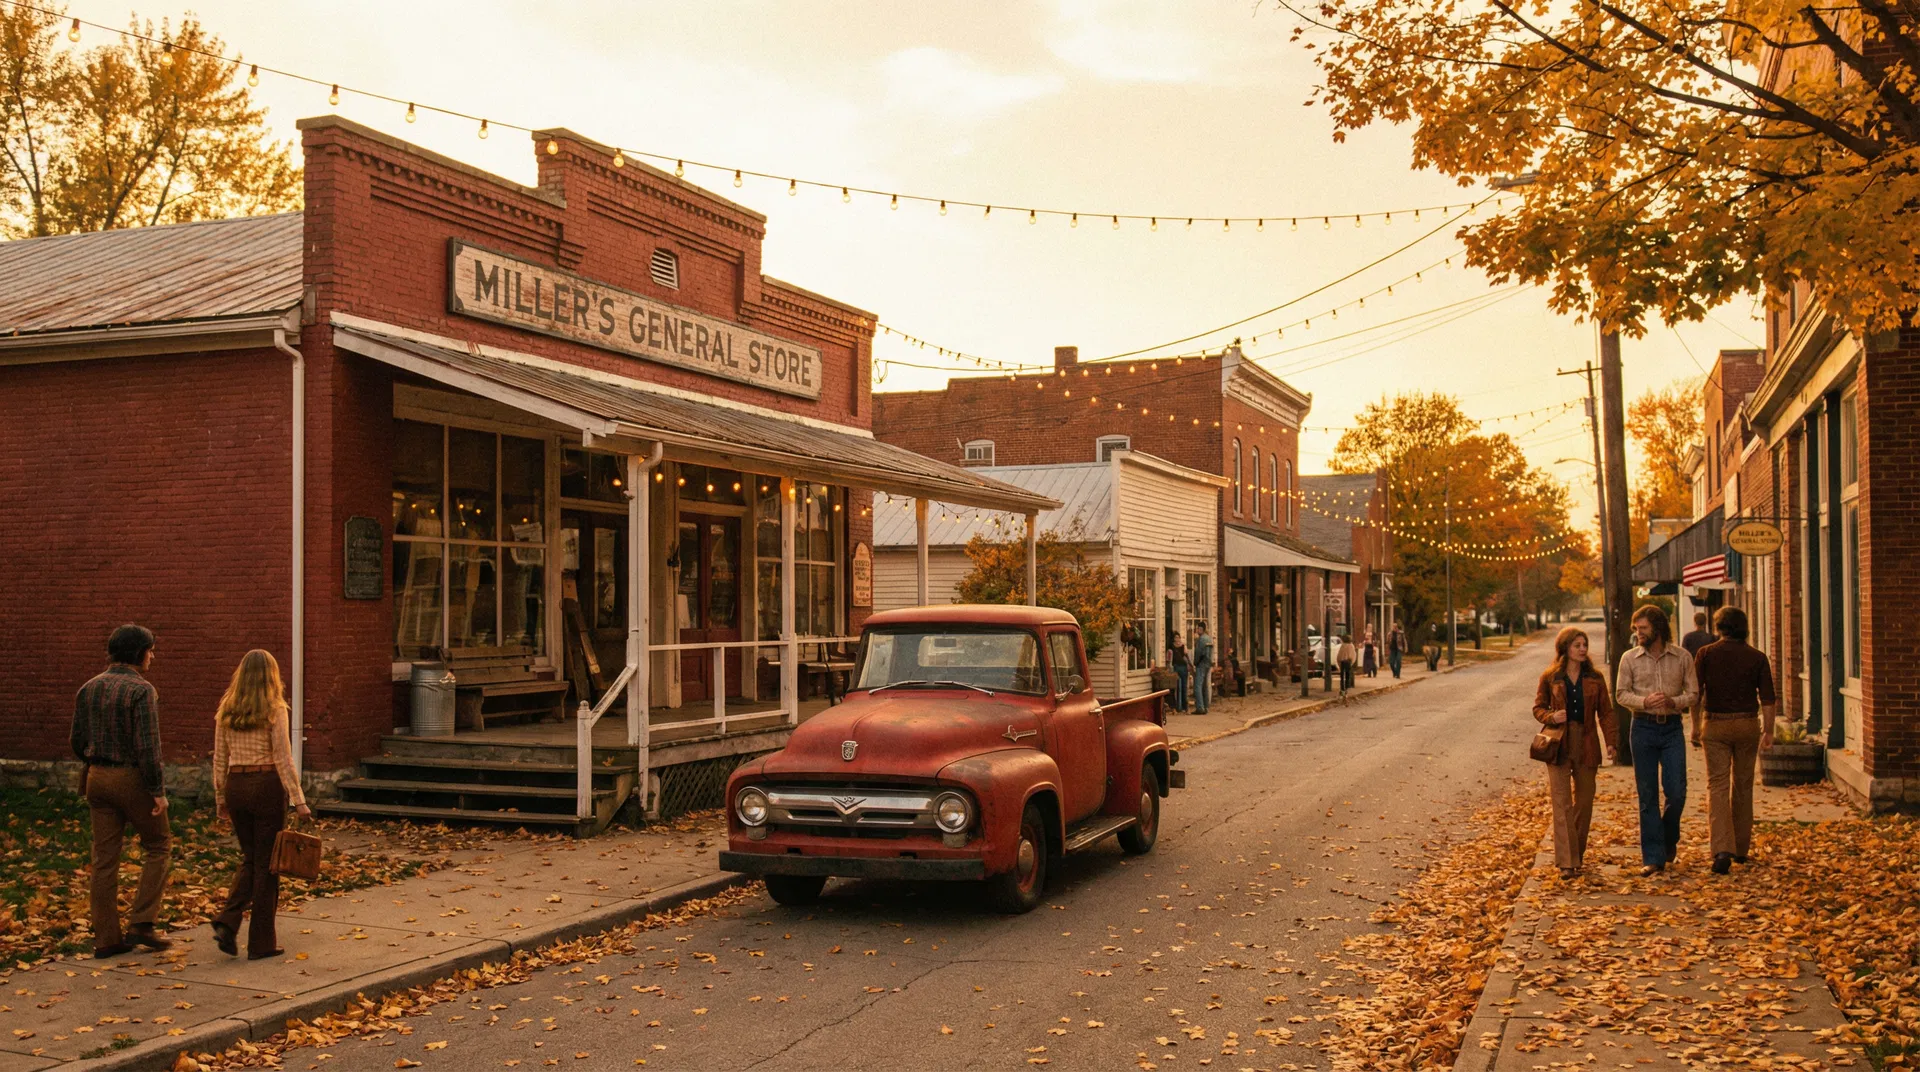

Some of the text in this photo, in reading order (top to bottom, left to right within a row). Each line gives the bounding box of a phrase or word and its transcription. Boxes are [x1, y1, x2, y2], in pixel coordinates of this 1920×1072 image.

[474, 260, 812, 387] MILLER'S GENERAL STORE
